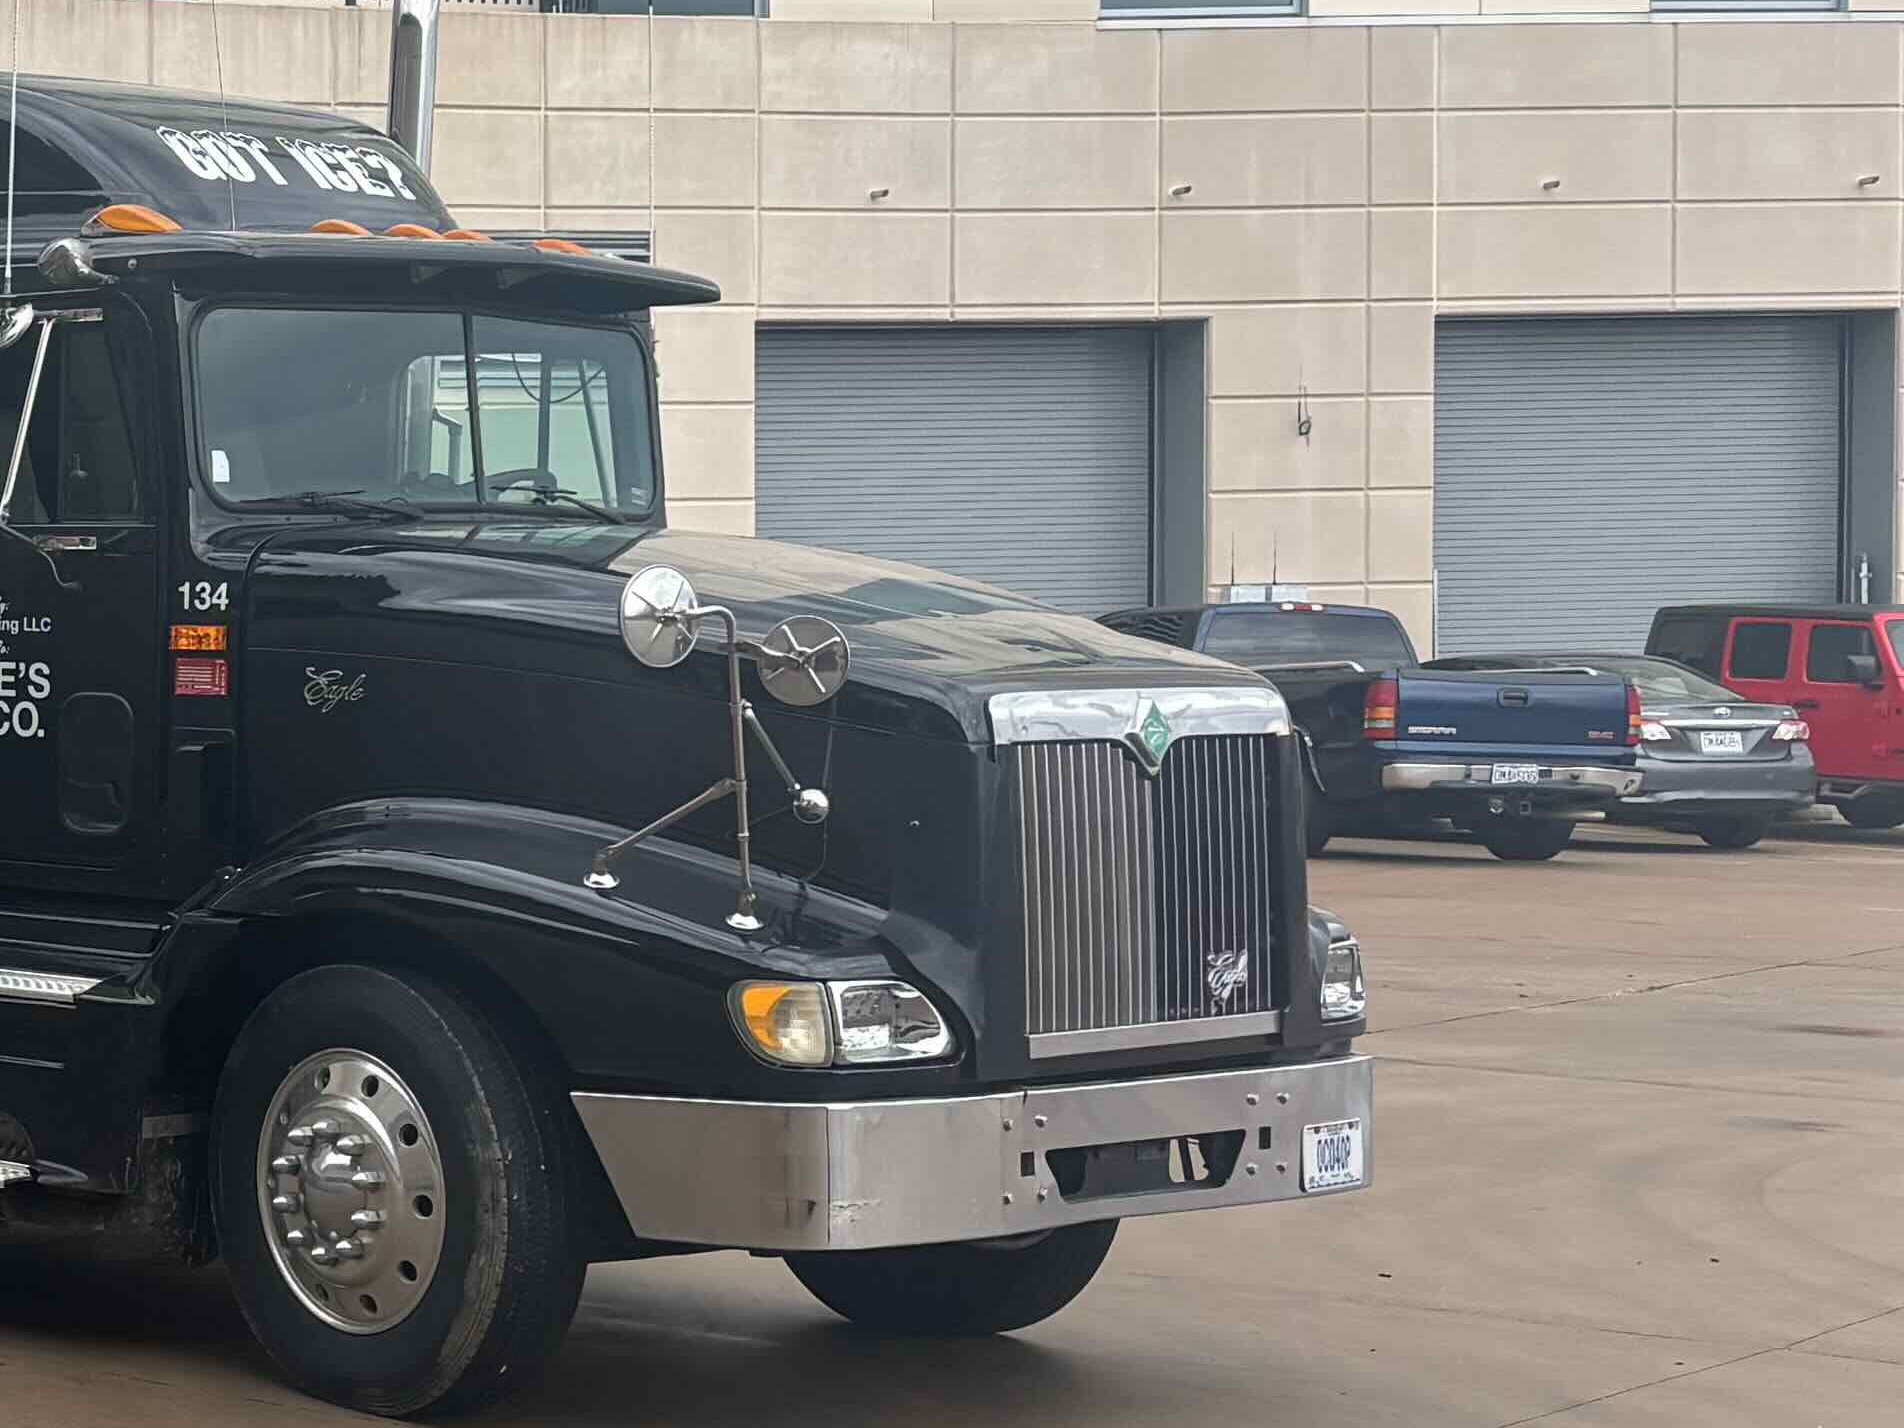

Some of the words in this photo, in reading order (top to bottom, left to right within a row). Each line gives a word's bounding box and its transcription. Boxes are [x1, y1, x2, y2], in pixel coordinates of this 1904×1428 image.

[155, 125, 289, 186] GOT
[275, 135, 417, 201] ICE?
[177, 580, 230, 611] 134
[23, 617, 52, 632] LLC
[304, 667, 367, 713] Eagle
